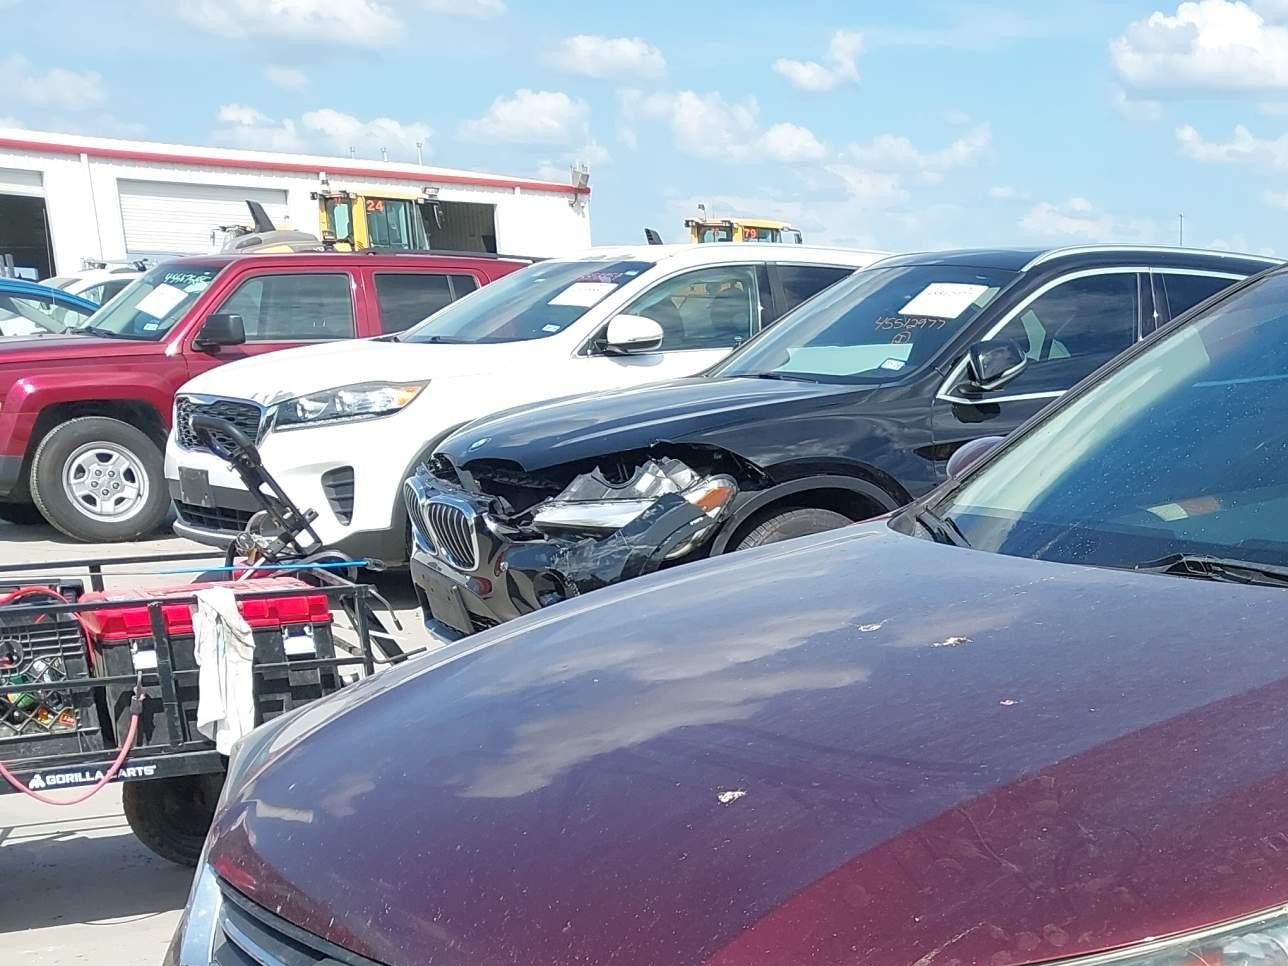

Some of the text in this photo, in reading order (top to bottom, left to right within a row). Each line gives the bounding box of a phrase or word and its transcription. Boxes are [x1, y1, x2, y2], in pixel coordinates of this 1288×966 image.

[367, 200, 384, 212] 24
[875, 316, 946, 330] 45512977
[45, 764, 155, 786] GORILLA ARTS
